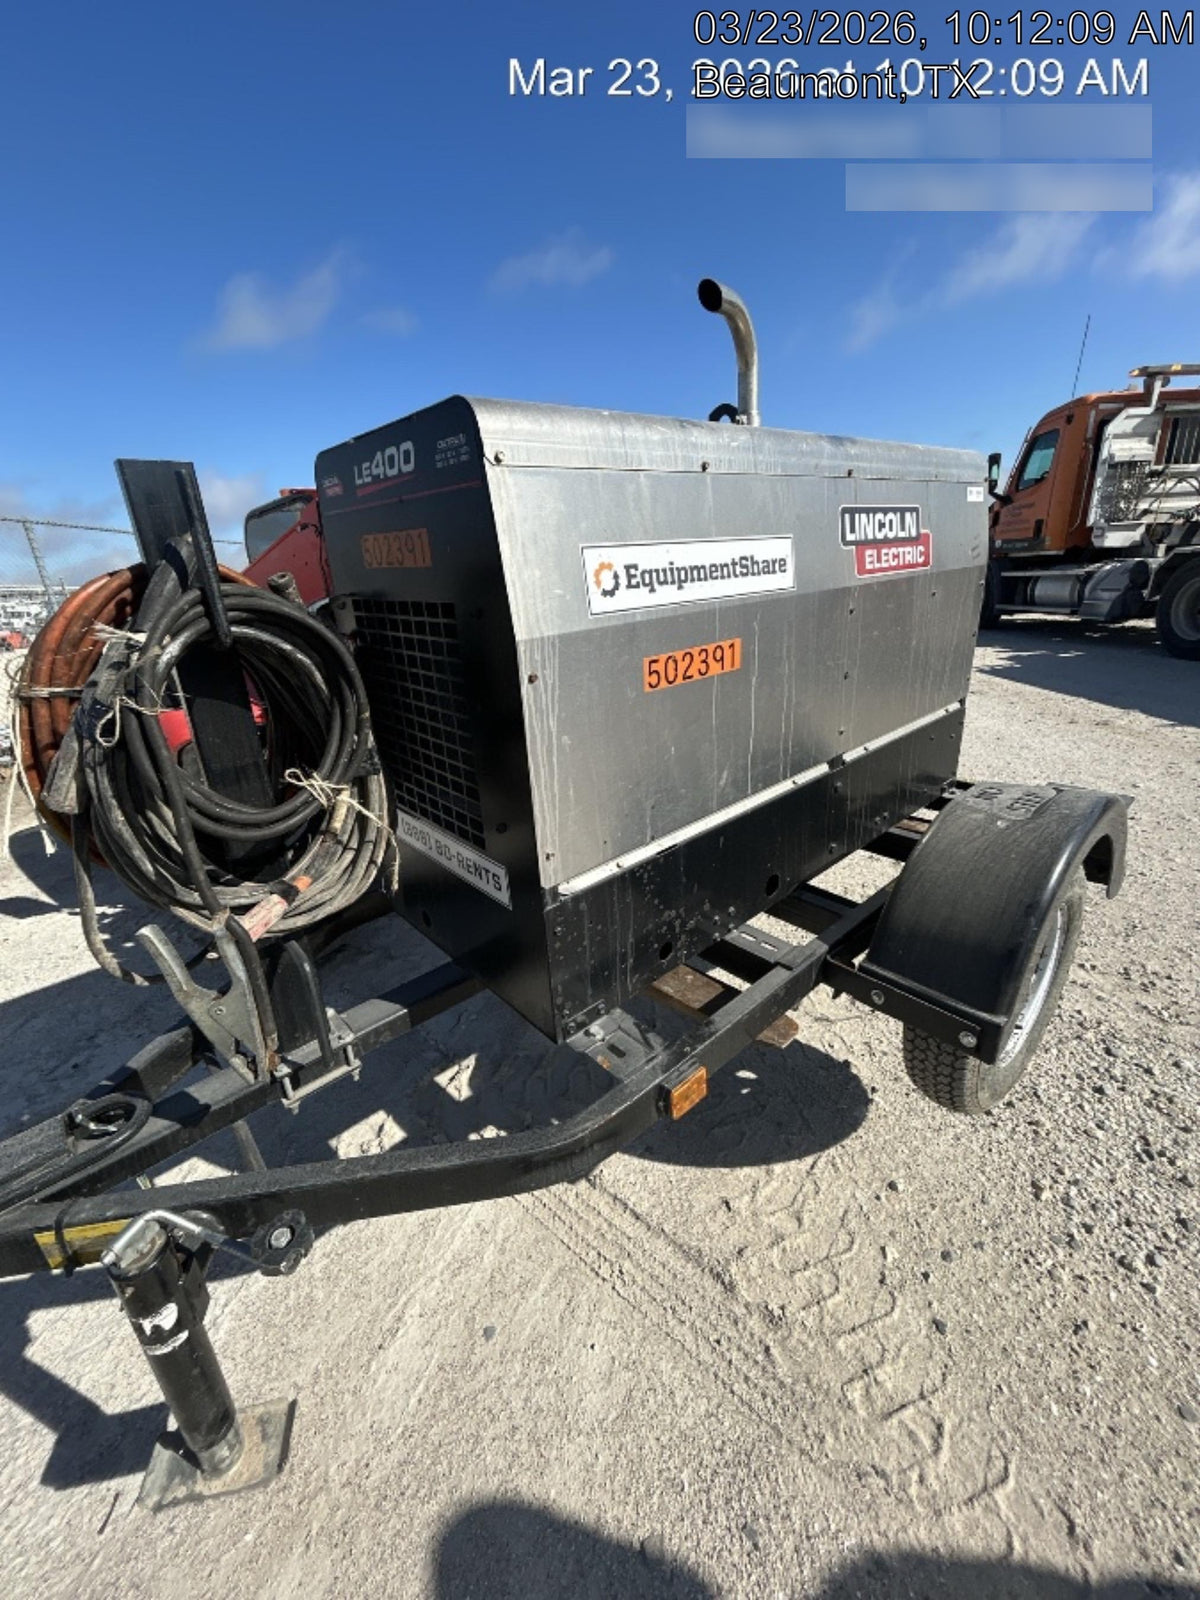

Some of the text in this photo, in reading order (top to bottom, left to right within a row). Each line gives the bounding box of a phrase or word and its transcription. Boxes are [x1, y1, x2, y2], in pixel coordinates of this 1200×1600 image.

[353, 440, 415, 485] LE400
[843, 510, 918, 541] LINCOLN
[363, 532, 427, 568] 502391
[864, 545, 926, 570] ELECTRIC
[624, 555, 787, 593] EquipmentShare
[647, 642, 737, 689] 502391
